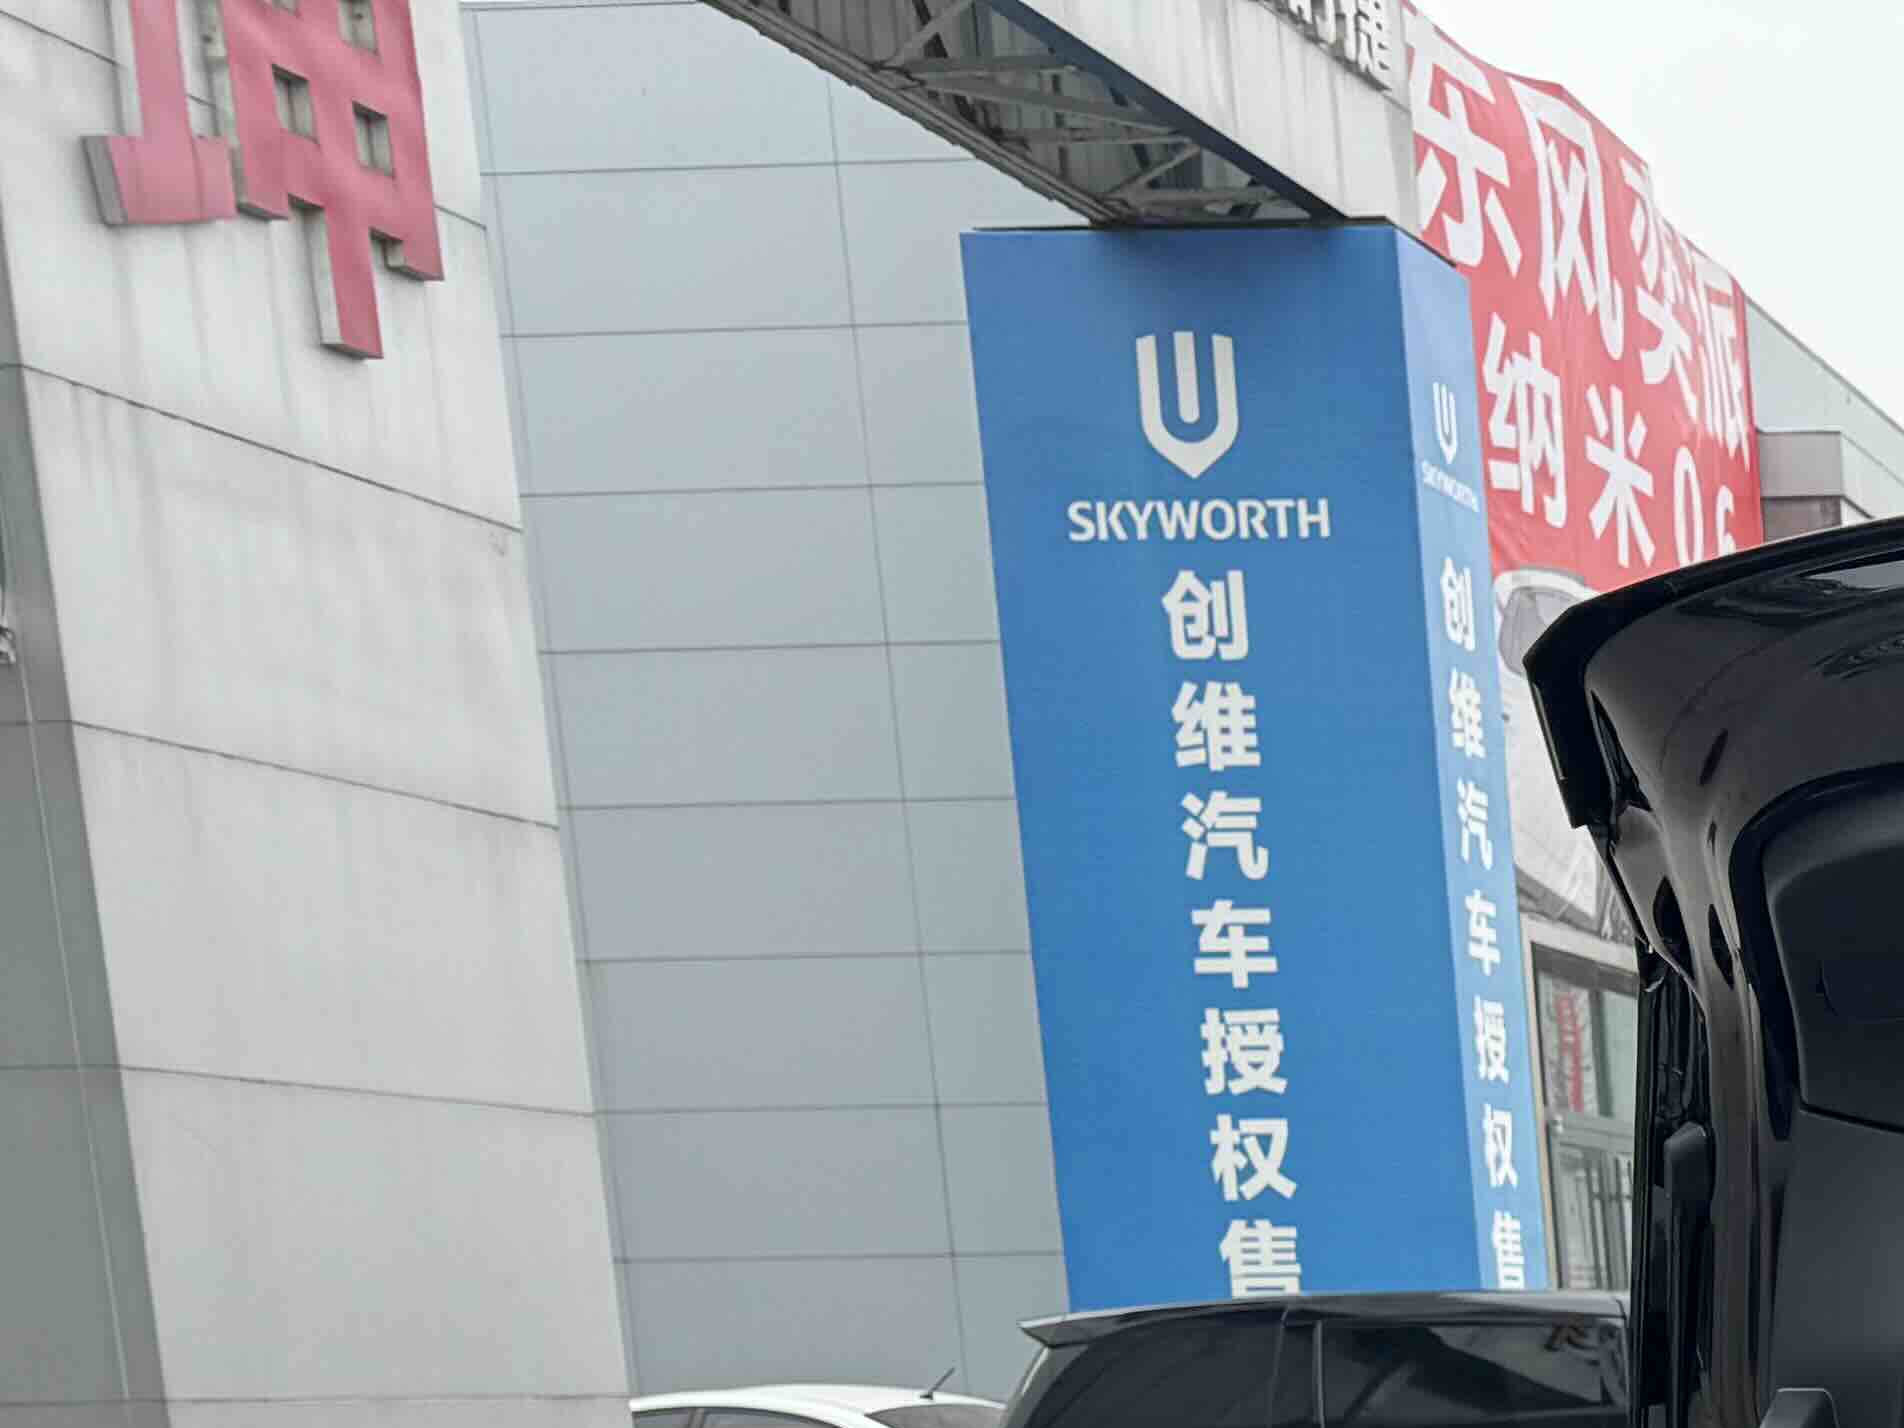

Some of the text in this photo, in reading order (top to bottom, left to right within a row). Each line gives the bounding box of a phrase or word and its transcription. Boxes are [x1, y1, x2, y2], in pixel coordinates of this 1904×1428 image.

[1067, 498, 1330, 542] SKYWORTH
[1162, 569, 1303, 1297] 创维汽车授权售
[1440, 558, 1525, 1289] 创维汽车授权售
